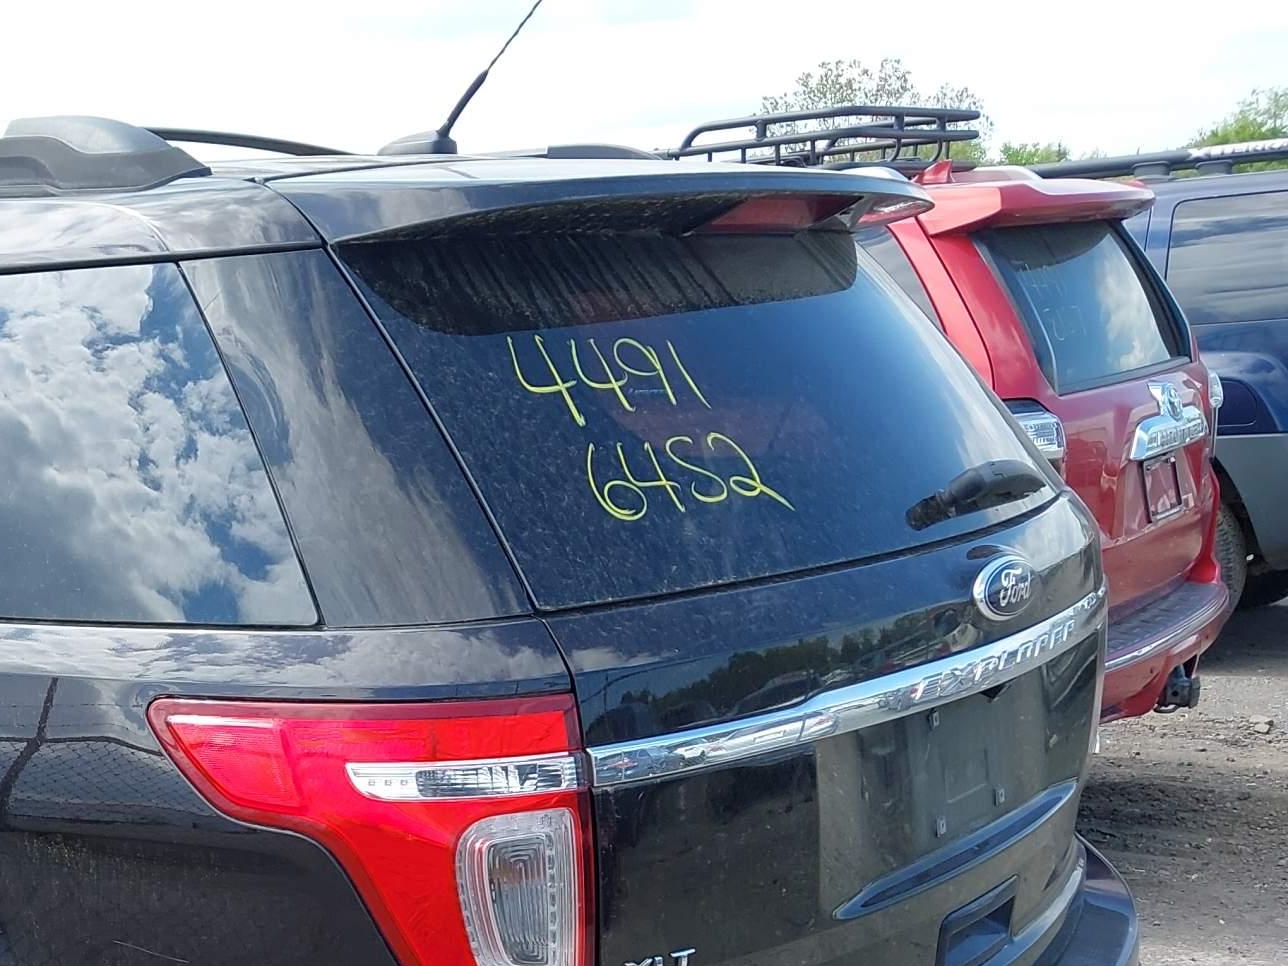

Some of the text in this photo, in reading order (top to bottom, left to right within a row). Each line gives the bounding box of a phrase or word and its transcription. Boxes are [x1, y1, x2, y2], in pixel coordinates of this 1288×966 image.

[506, 333, 712, 427] 4491
[585, 431, 796, 521] 6452
[999, 567, 1032, 607] Ford
